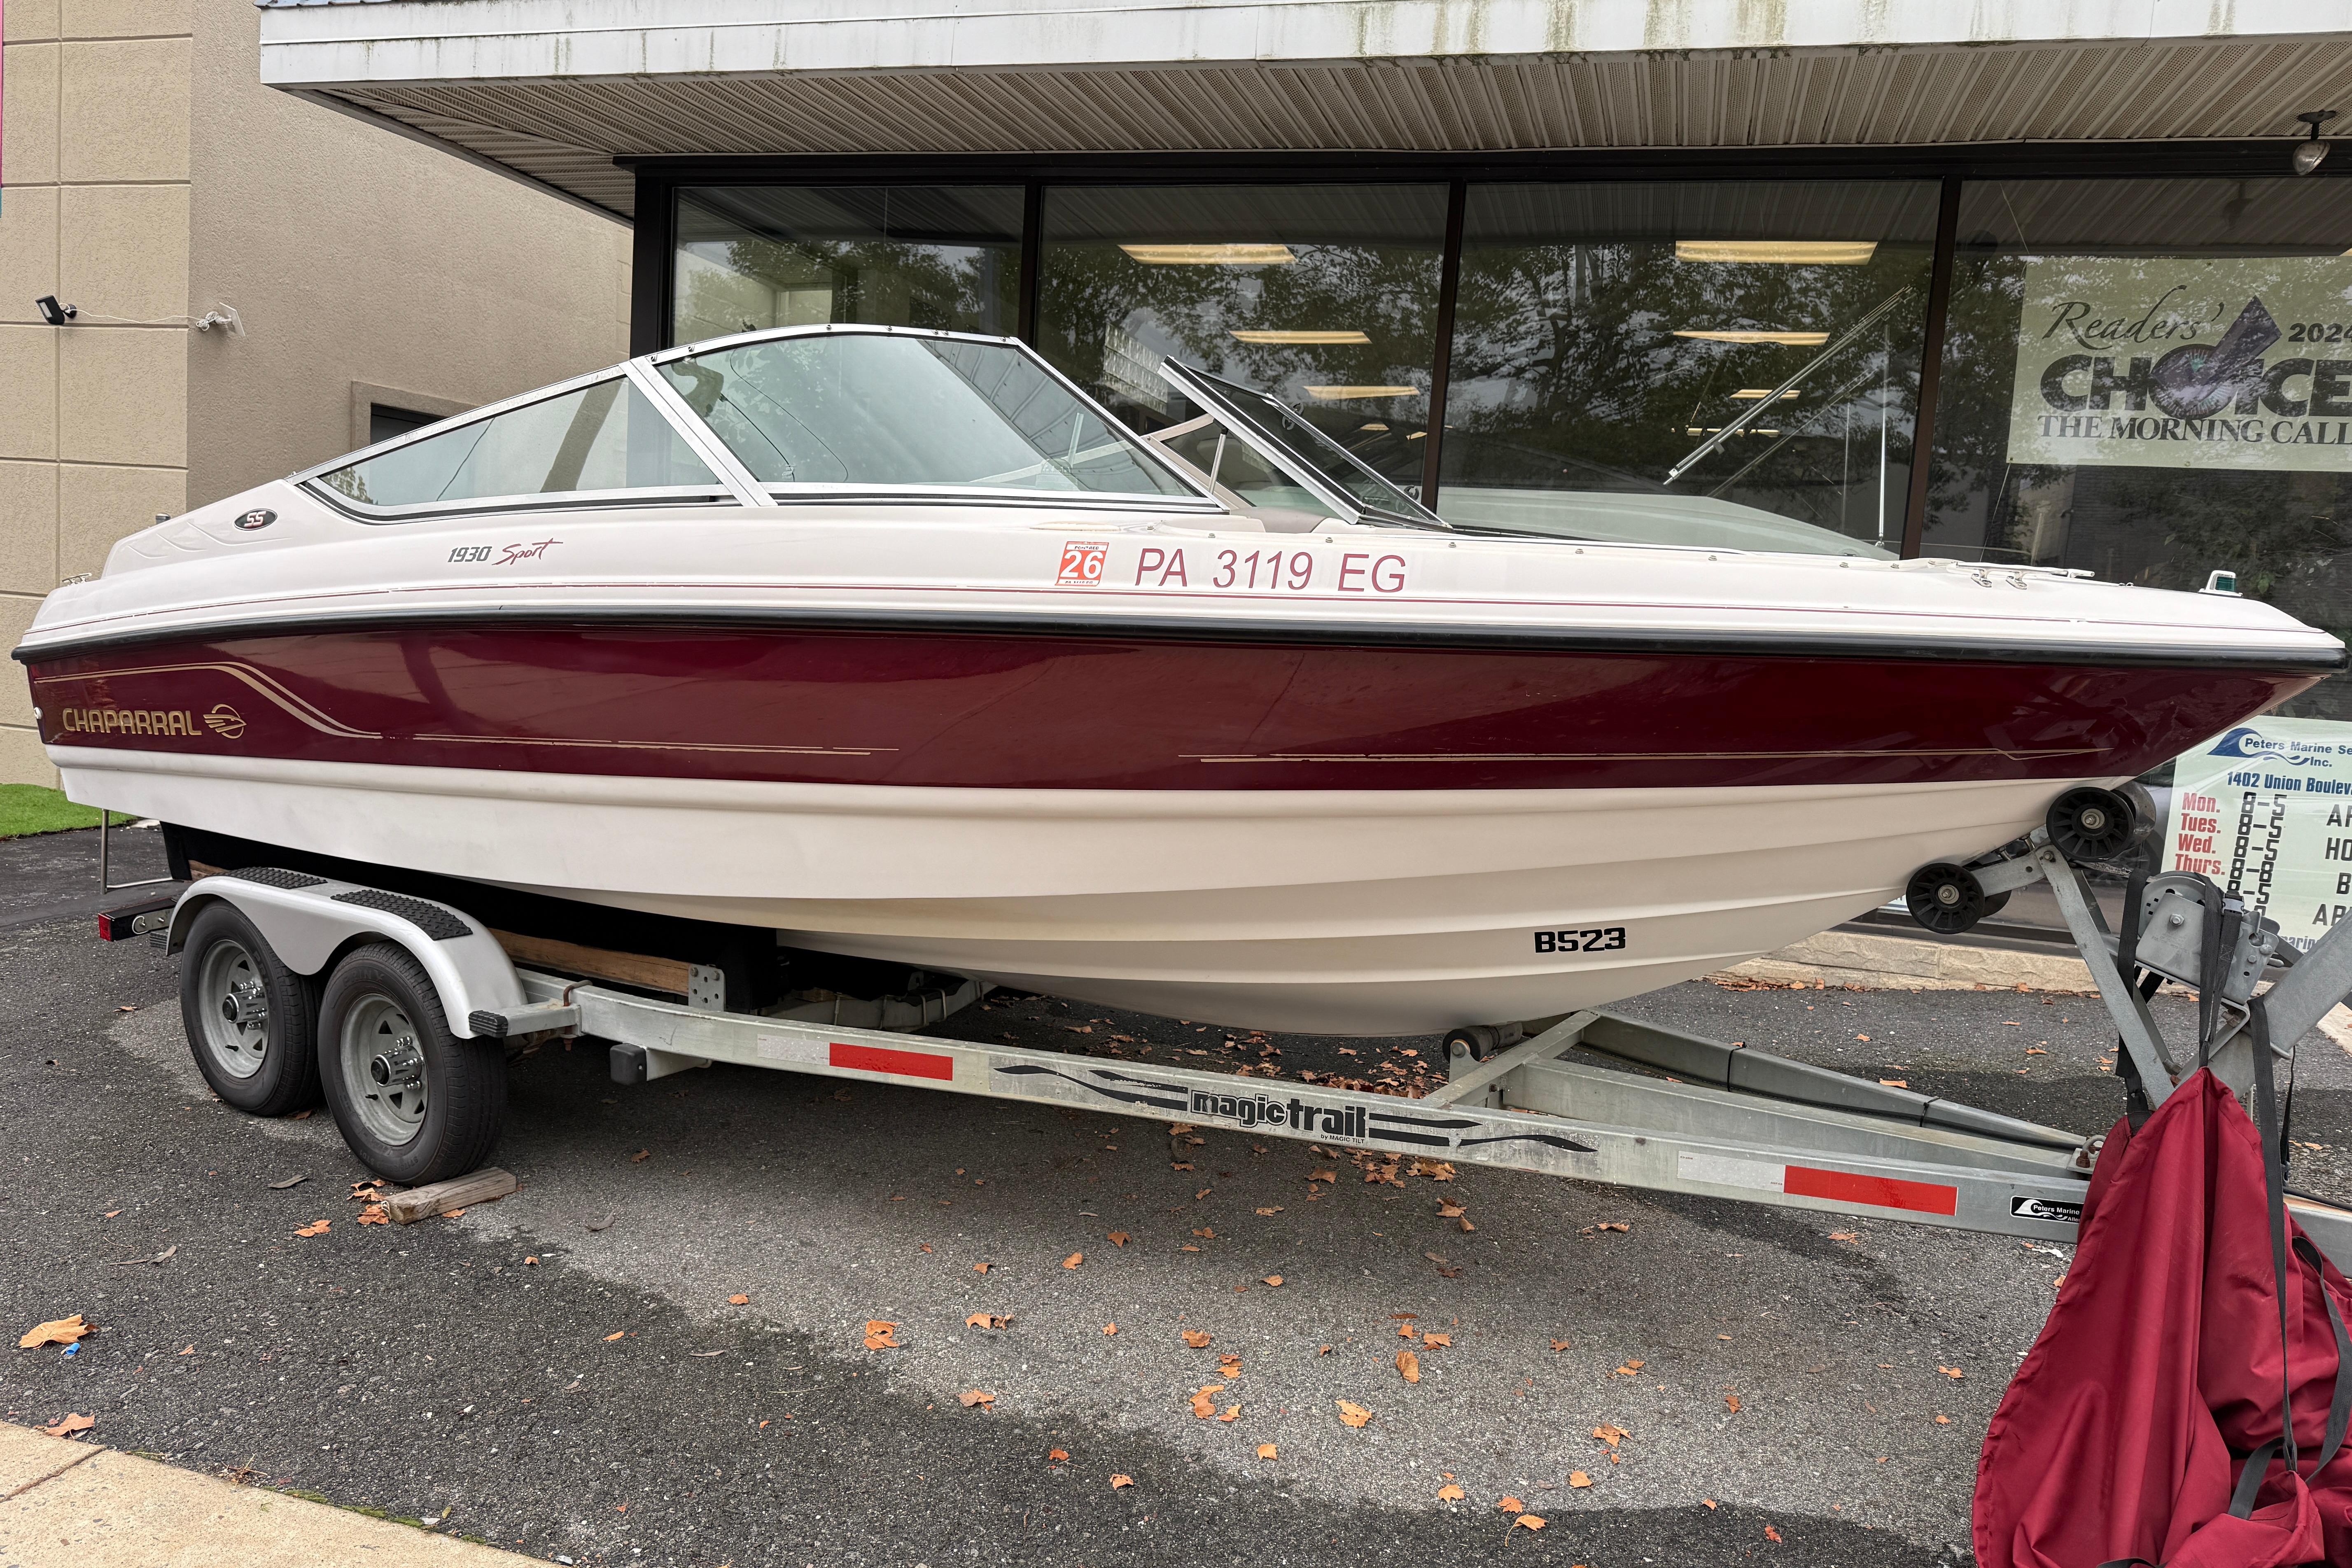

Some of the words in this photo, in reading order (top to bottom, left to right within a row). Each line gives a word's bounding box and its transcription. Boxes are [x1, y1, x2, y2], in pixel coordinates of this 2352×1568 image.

[2040, 344, 2352, 420] CHOICE
[2037, 415, 2102, 438] THE
[2107, 417, 2263, 443] MORNING
[2270, 420, 2352, 445] CALL
[244, 511, 266, 527] SS
[448, 546, 492, 562] 1930
[491, 538, 563, 565] Sport
[1060, 550, 1104, 579] 26
[1135, 548, 1188, 586] PA
[1213, 550, 1313, 590] 3119
[1337, 553, 1406, 593] EG
[63, 708, 202, 735] CHAPARRAL
[2245, 738, 2285, 750] Peters
[2290, 741, 2332, 753] Marine
[2310, 756, 2332, 767] Inc.
[2227, 772, 2260, 787] 1402
[2264, 774, 2301, 791] Union
[2306, 777, 2352, 795] Boulev
[2182, 792, 2220, 813] Mon.
[2181, 813, 2221, 833] Tues.
[2179, 833, 2216, 854] Wed.
[2175, 853, 2225, 875] Thurs.
[2312, 904, 2352, 926] AP
[1534, 927, 1626, 953] B523
[2281, 936, 2317, 950] arin
